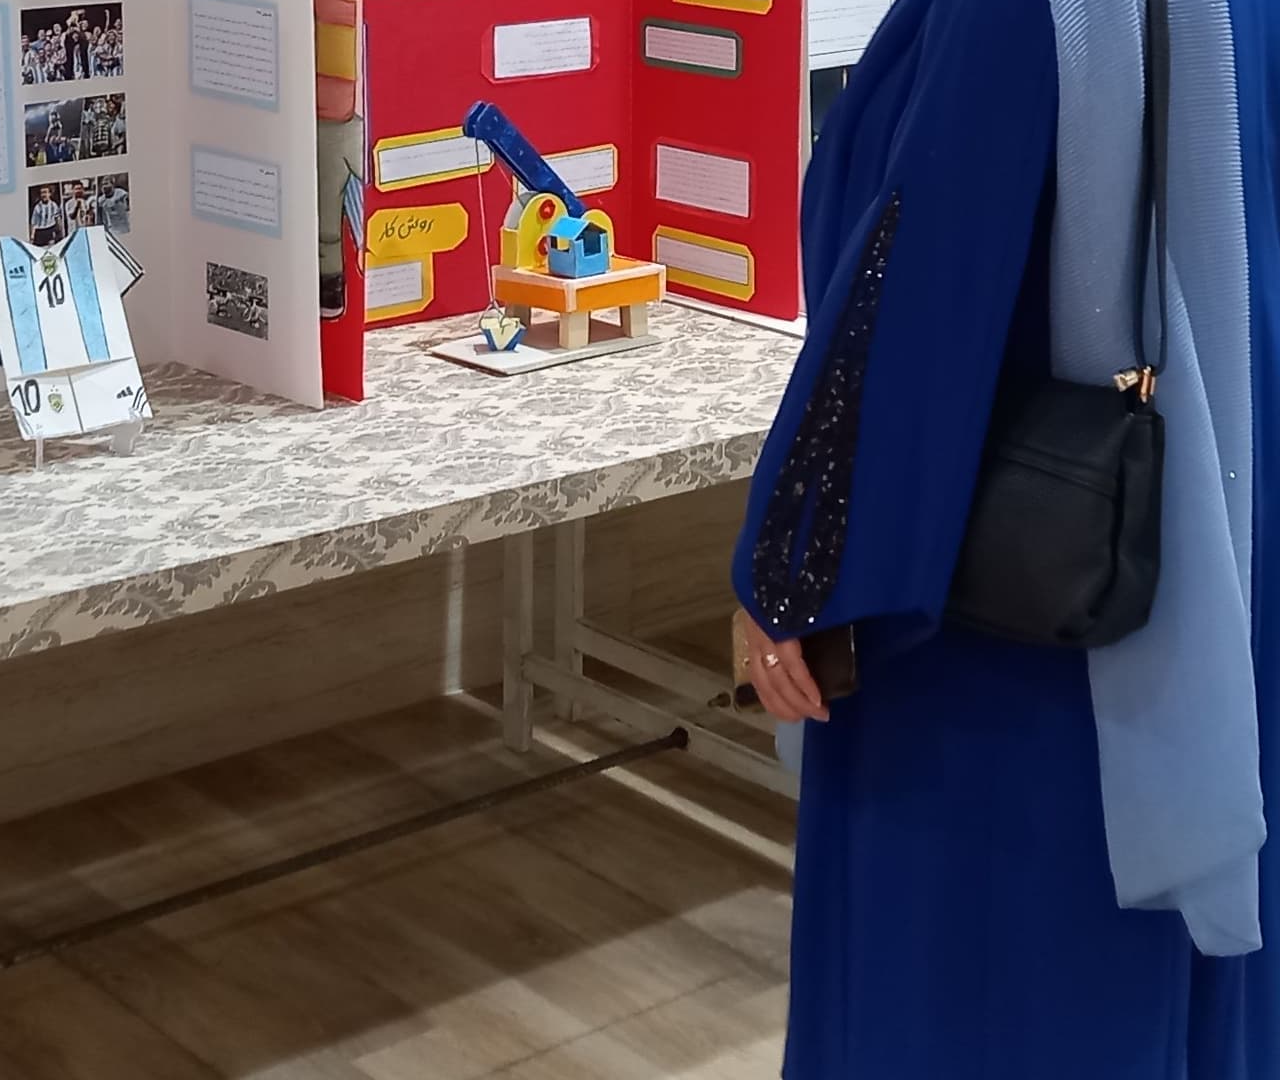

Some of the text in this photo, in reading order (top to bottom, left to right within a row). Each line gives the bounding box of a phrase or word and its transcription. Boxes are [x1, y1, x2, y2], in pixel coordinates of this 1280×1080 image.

[378, 215, 435, 242] روش کار
[38, 273, 65, 308] 10
[11, 378, 41, 417] 10
